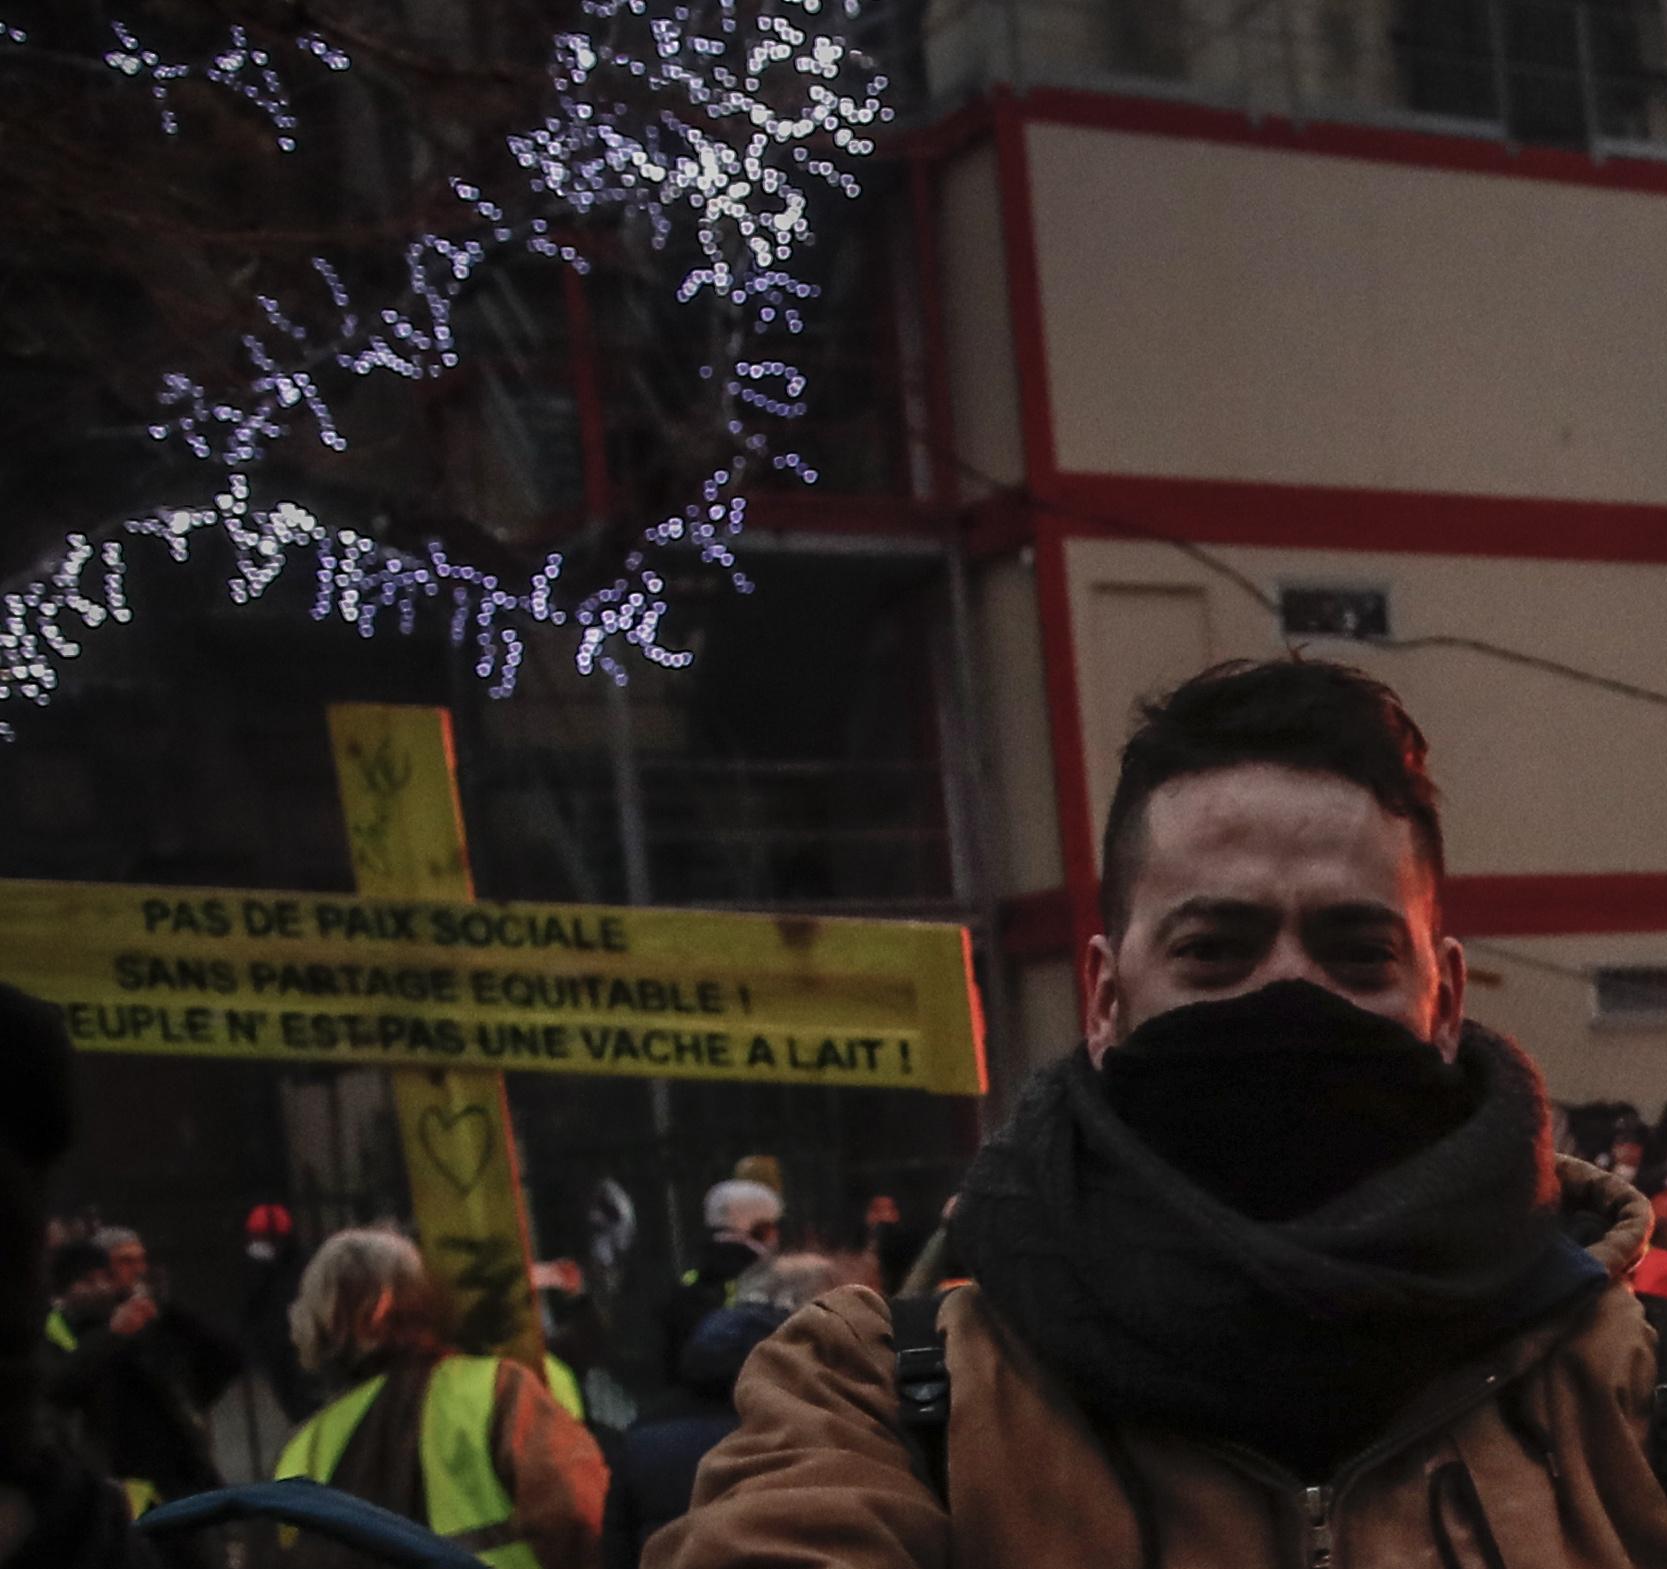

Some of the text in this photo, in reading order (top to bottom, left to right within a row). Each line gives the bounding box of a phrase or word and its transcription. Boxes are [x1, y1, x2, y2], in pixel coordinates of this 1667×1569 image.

[143, 899, 627, 951] PAS DE PAIX SOCIALE
[115, 954, 239, 993] SANS
[250, 960, 458, 1001] PARTAGE
[471, 969, 723, 1013] EQUITABLE
[66, 1002, 211, 1042] EUPLE
[377, 1014, 465, 1054] PAS
[477, 1023, 568, 1058] UNE
[580, 1027, 730, 1068] VACHE
[748, 1034, 776, 1066] A
[786, 1037, 883, 1072] LAIT
[899, 1039, 912, 1074] !
